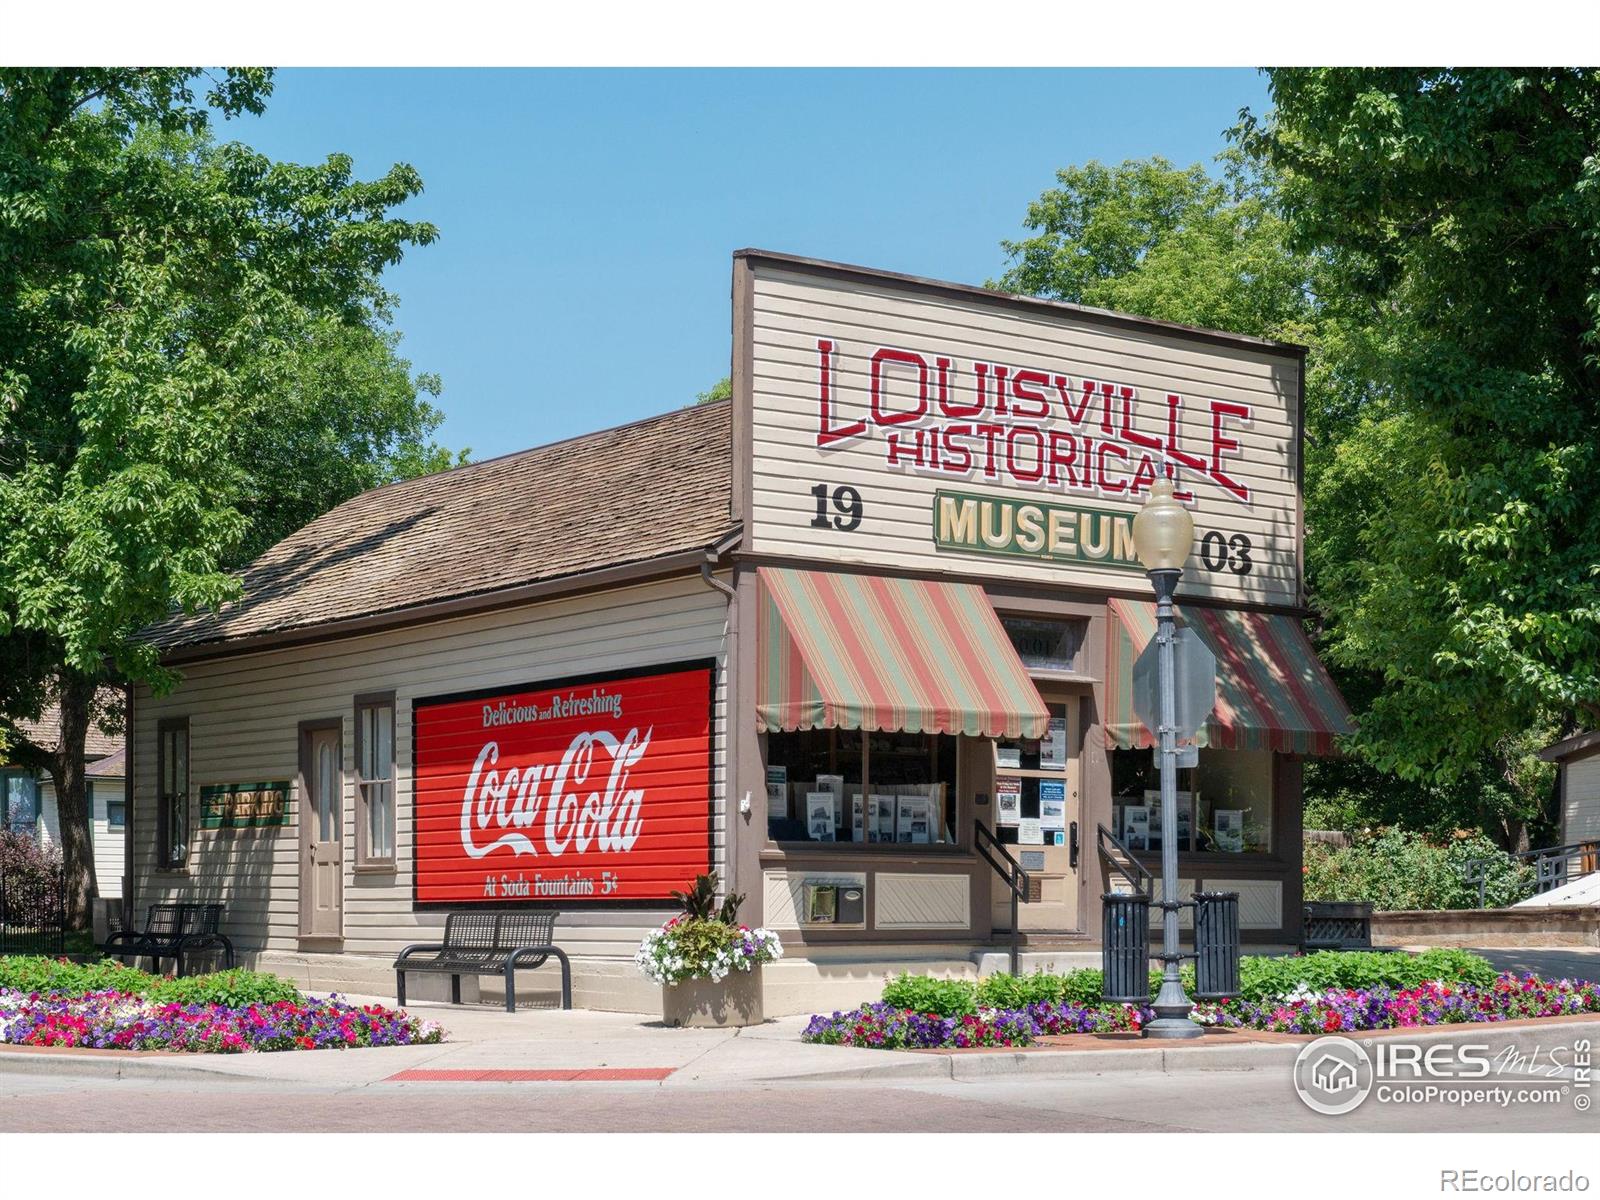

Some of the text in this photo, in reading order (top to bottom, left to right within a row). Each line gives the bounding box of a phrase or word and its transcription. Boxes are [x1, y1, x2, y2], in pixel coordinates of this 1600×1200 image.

[816, 339, 1251, 502] LOUISVILLE
[887, 423, 1194, 502] HISTORICAL
[810, 483, 864, 532] 19
[939, 495, 1144, 563] MUSEUM
[1201, 530, 1253, 576] 03
[482, 688, 623, 728] Delicious and Refreshing
[224, 789, 284, 819] PARKING
[460, 723, 654, 860] Coca-Cola
[483, 874, 497, 897] At
[501, 872, 530, 897] Soda
[534, 870, 595, 897] Fountains
